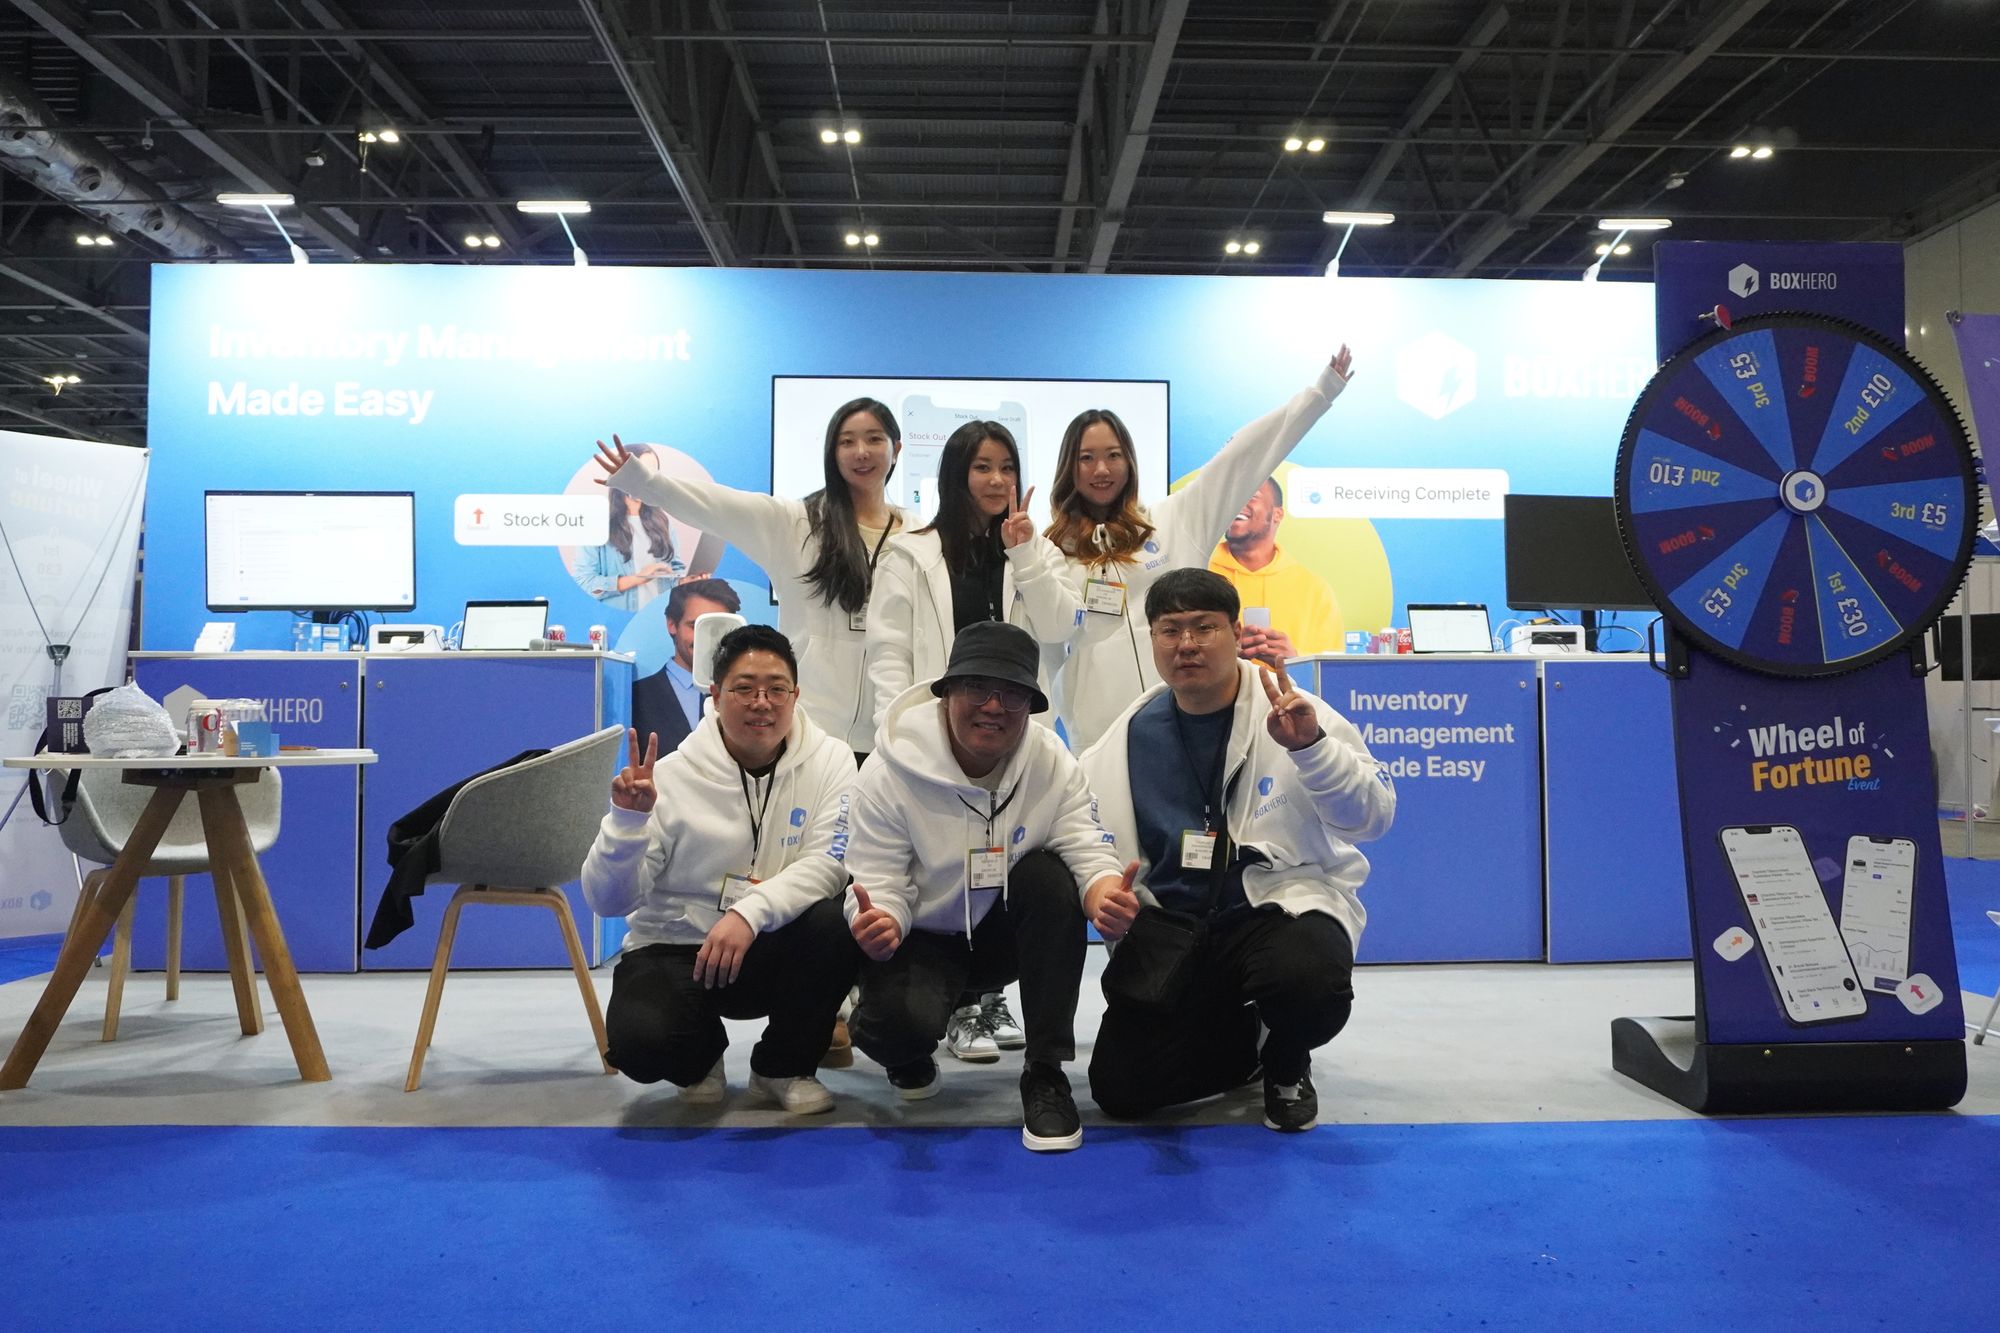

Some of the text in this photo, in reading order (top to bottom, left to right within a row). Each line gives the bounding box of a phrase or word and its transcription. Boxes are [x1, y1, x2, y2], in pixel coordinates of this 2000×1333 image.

[1770, 272, 1837, 290] BOXHERO
[417, 323, 691, 368] Mangent
[1504, 355, 1657, 398] BOXHER
[1730, 353, 1757, 379] £5
[1804, 346, 1819, 382] BOOM
[208, 381, 435, 425] Made Easy
[1746, 382, 1770, 408] 3rd
[1845, 405, 1870, 435] 2nd
[1861, 373, 1891, 409] £10
[1674, 396, 1709, 427] BOOM
[909, 432, 947, 441] Stock Out
[1900, 434, 1936, 457] BOOM
[1650, 463, 1720, 487] 2nd £10
[1334, 486, 1491, 503] Receiving Complete
[503, 513, 585, 527] Stock Out
[1891, 502, 1947, 525] 3rd £5
[1659, 531, 1696, 554] BOOM
[1724, 563, 1748, 590] 3rd
[1889, 562, 1922, 593] BOOM
[1705, 588, 1732, 618] £5
[1828, 571, 1846, 594] 1st
[1838, 598, 1868, 636] £30
[1778, 607, 1794, 644] BOOM
[227, 698, 323, 723] OXHERO
[1351, 689, 1468, 715] Inventory
[1352, 722, 1515, 749] Management
[1748, 716, 1865, 758] Wheel of
[1380, 755, 1486, 781] ade Easy
[1752, 754, 1871, 792] Fortune
[1848, 777, 1880, 791] Event
[1255, 794, 1288, 819] BOXHERO
